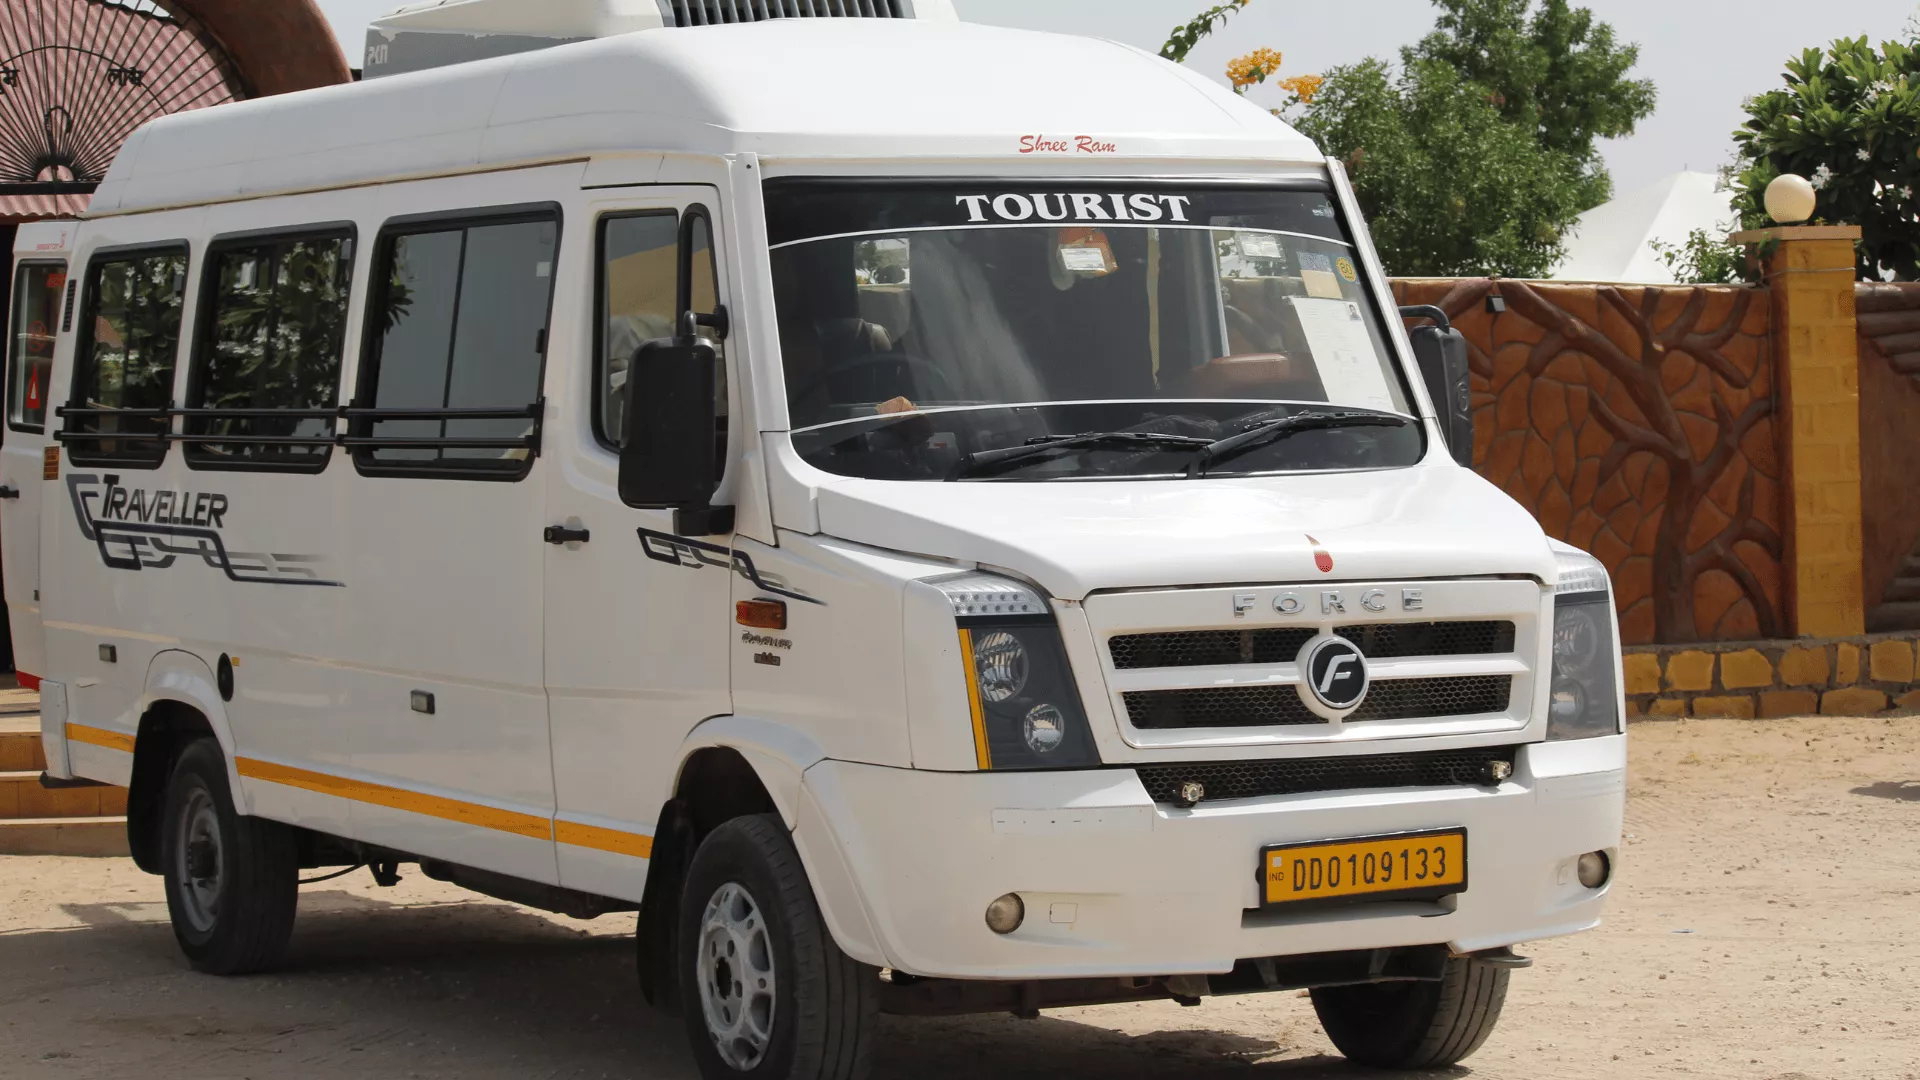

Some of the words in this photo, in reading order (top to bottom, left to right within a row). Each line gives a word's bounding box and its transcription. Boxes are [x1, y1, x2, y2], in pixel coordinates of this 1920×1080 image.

[1019, 134, 1068, 154] Shree
[1074, 135, 1116, 153] Ram
[955, 193, 1191, 222] TOURIST
[101, 474, 229, 528] TRAVELLER
[1233, 588, 1423, 617] FORCE
[1268, 872, 1285, 882] IND
[1292, 846, 1447, 892] DD01Q9133
